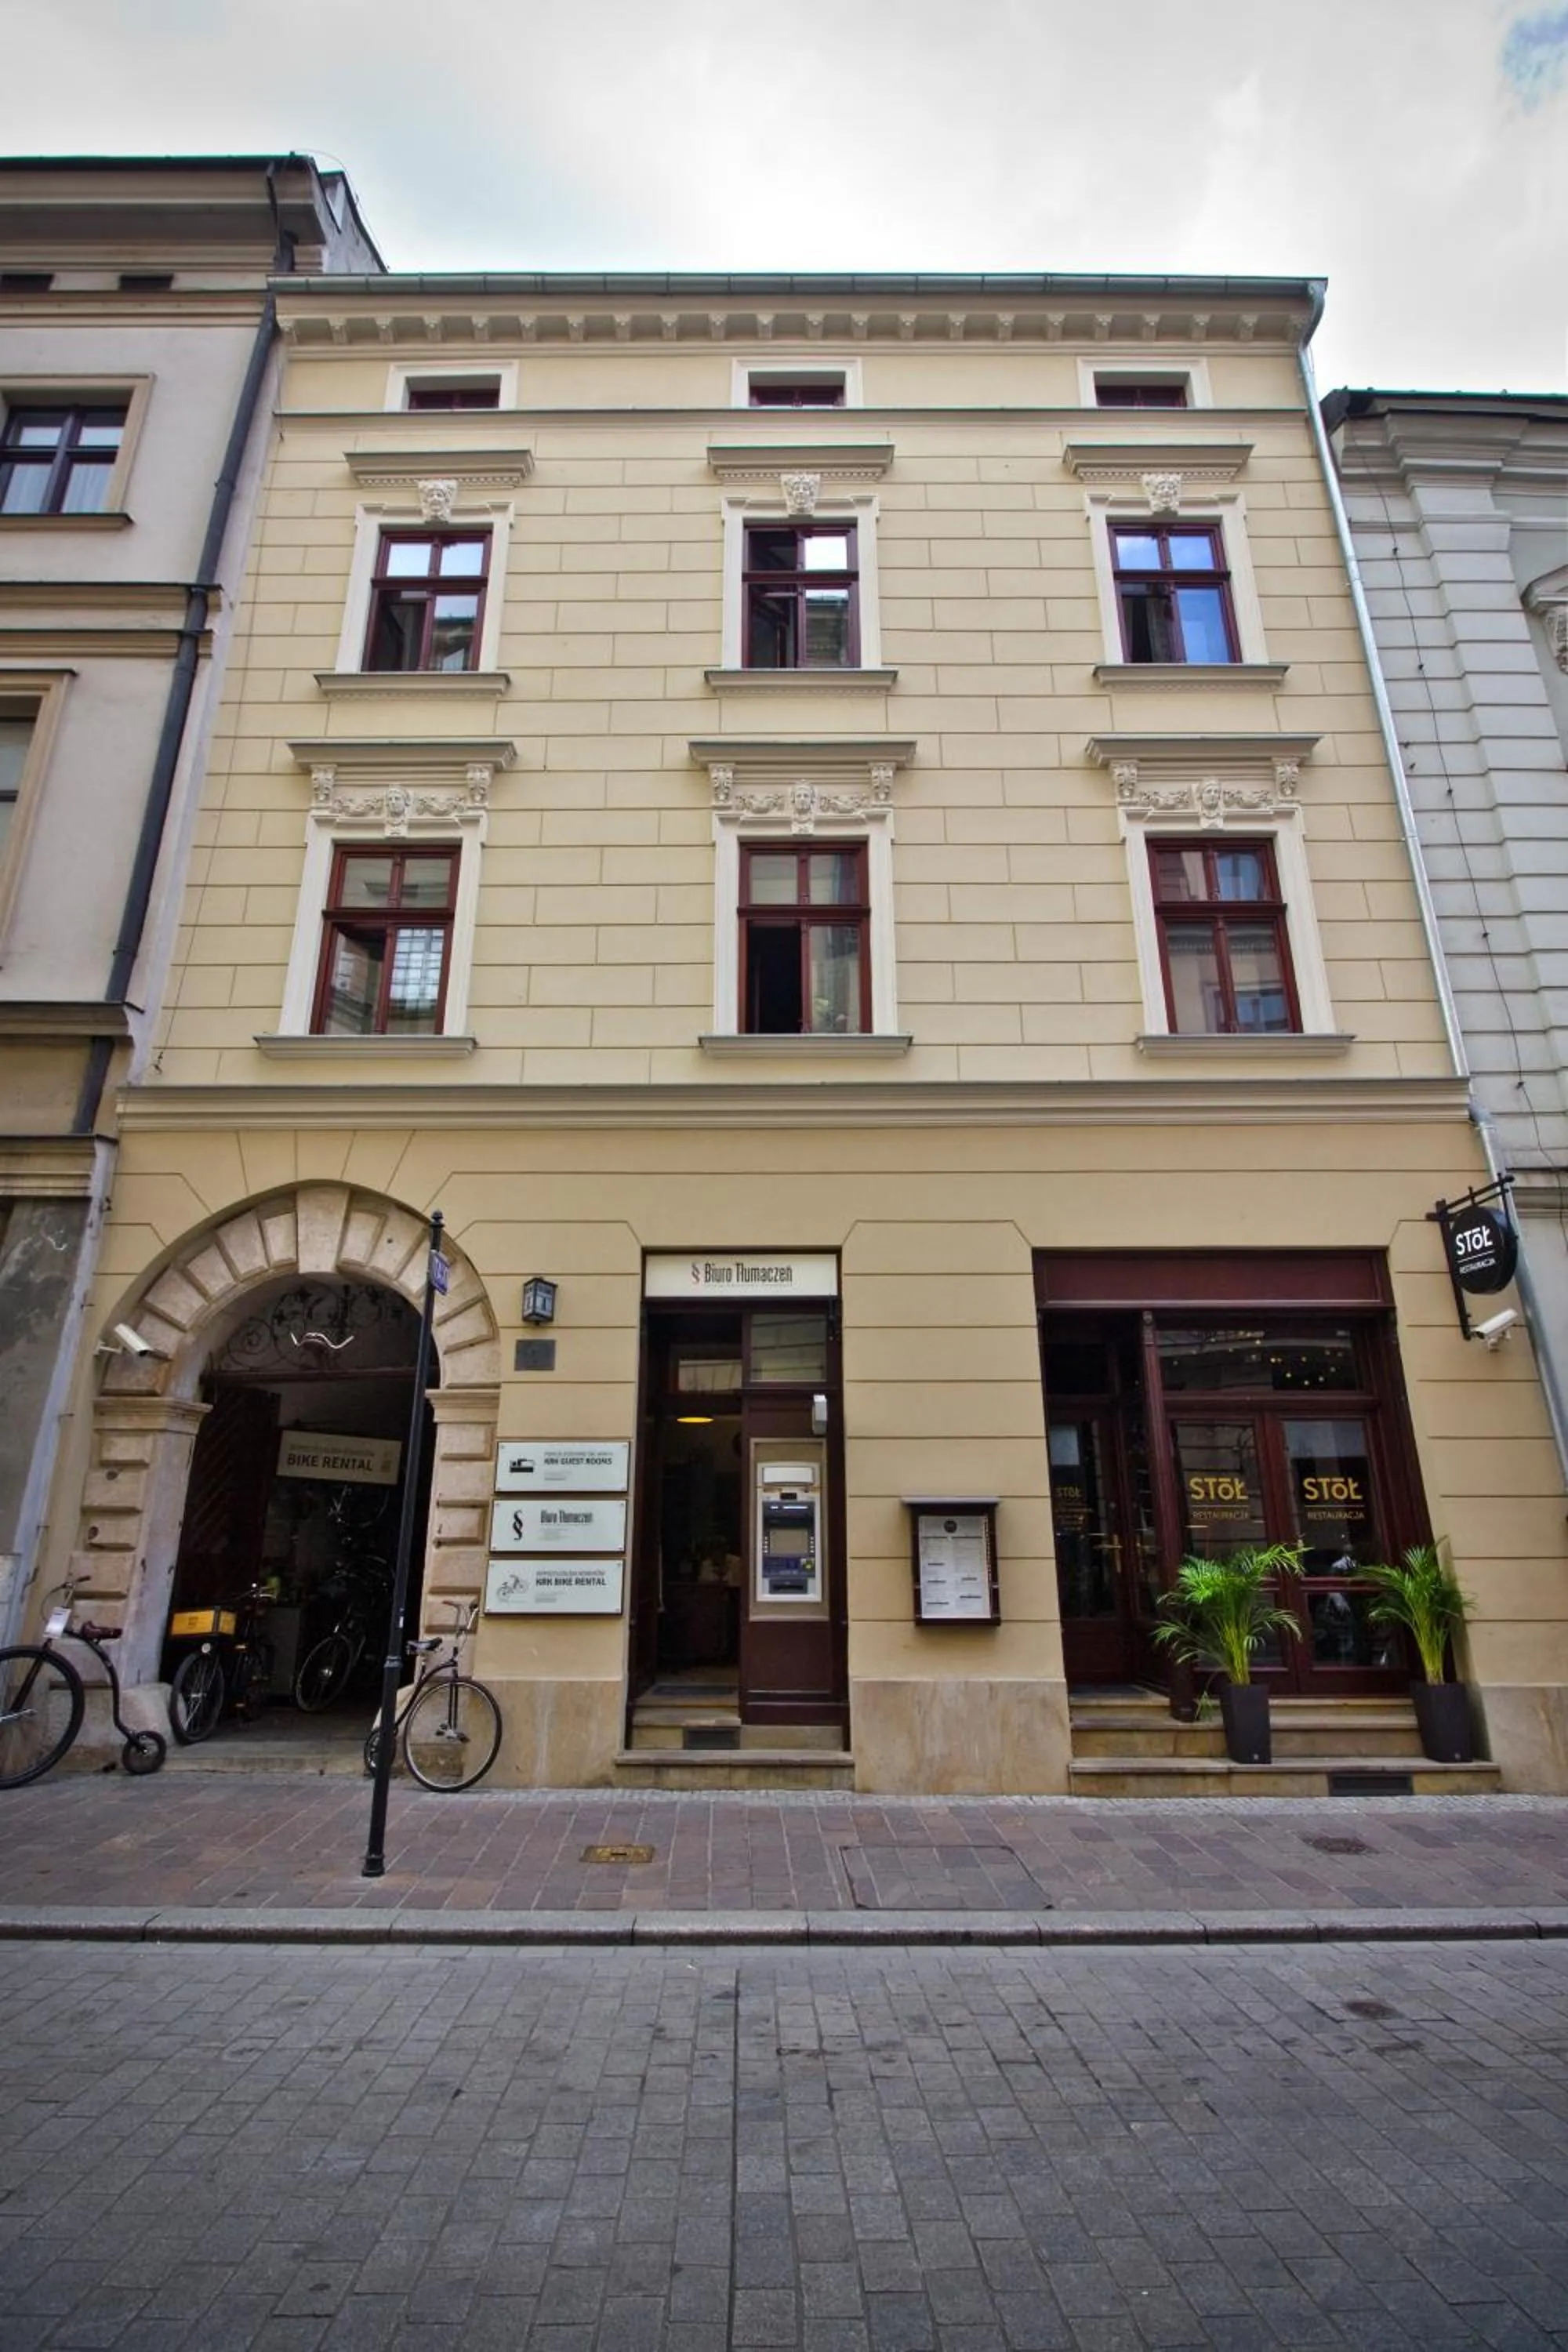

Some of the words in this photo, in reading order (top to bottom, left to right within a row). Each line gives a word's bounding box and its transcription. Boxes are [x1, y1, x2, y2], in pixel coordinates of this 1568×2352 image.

[705, 1262, 731, 1283] Biuro
[287, 1454, 319, 1468] BIKE
[321, 1456, 374, 1472] RENTAL
[554, 1577, 573, 1586] BIKE
[575, 1577, 608, 1586] RENTAL
